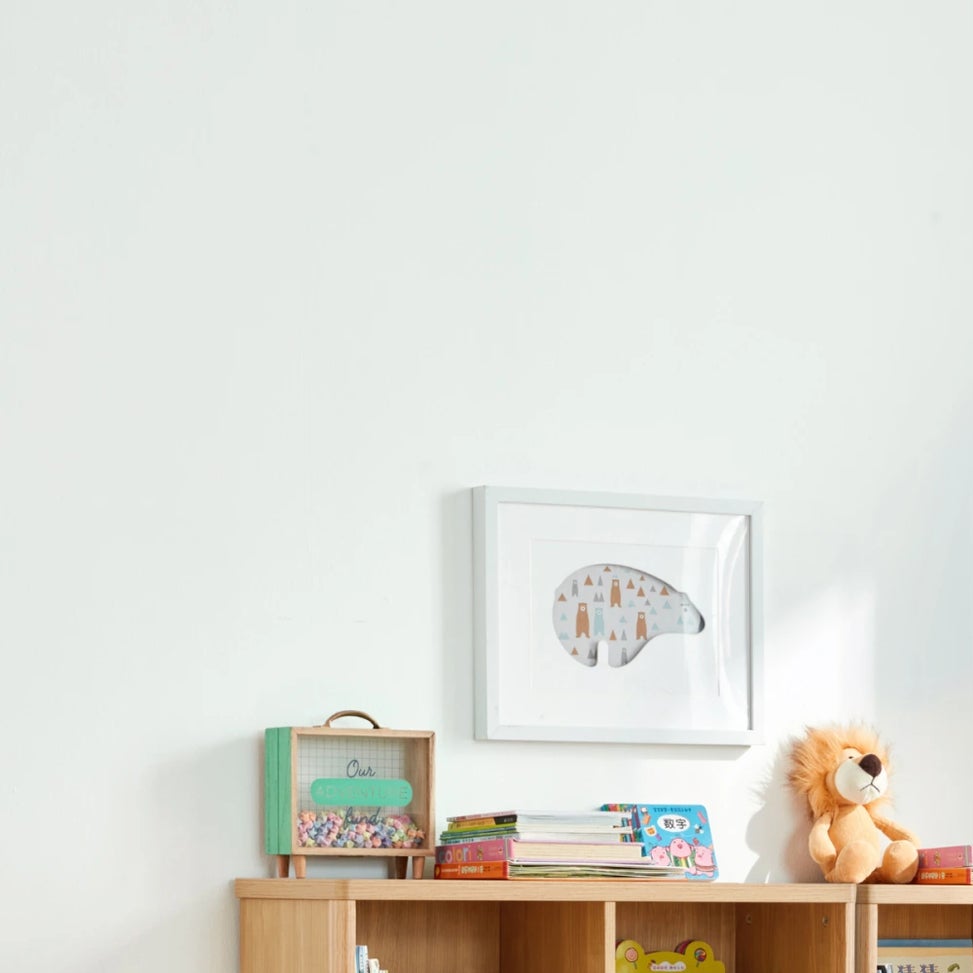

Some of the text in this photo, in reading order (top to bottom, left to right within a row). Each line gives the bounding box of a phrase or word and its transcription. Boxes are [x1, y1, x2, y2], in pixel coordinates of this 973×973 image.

[346, 759, 376, 778] Our
[343, 806, 384, 830] fund
[663, 818, 687, 830] 数字
